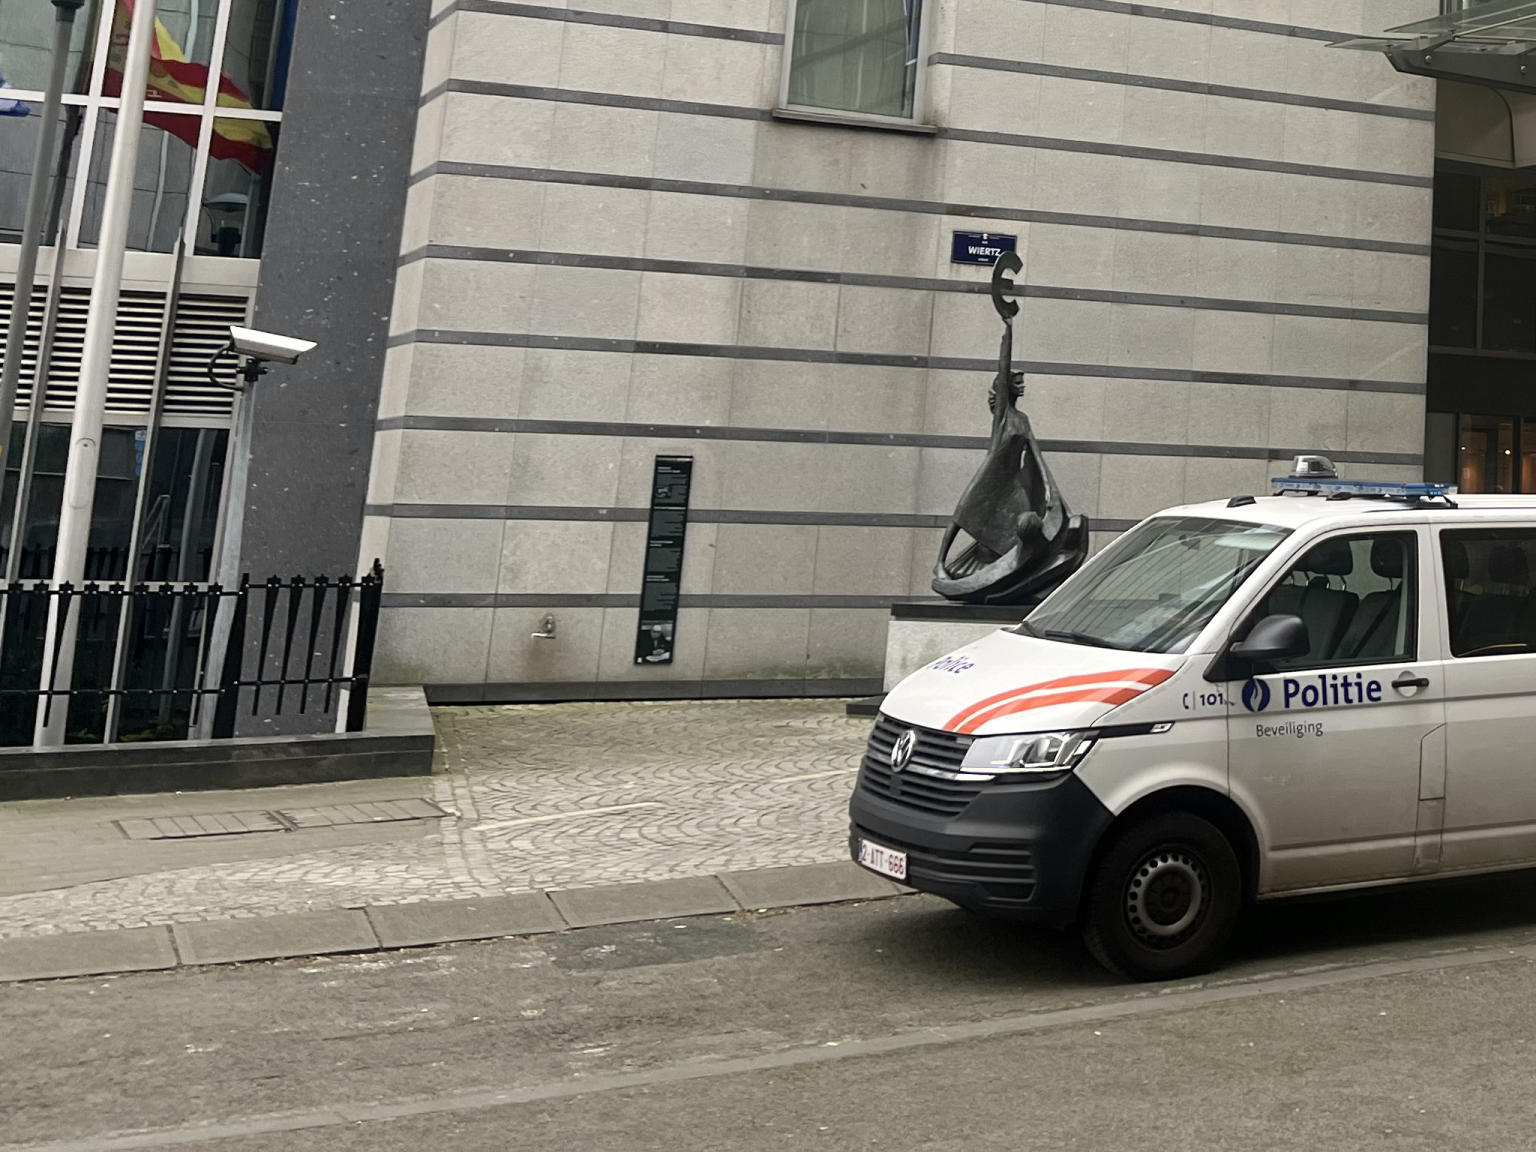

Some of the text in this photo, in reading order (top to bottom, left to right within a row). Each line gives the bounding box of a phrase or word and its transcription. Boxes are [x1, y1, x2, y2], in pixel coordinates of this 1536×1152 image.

[968, 245, 1001, 256] WIERTZ
[1283, 672, 1382, 709] Politie
[1200, 692, 1223, 707] 101
[1256, 721, 1323, 738] Beveiliging
